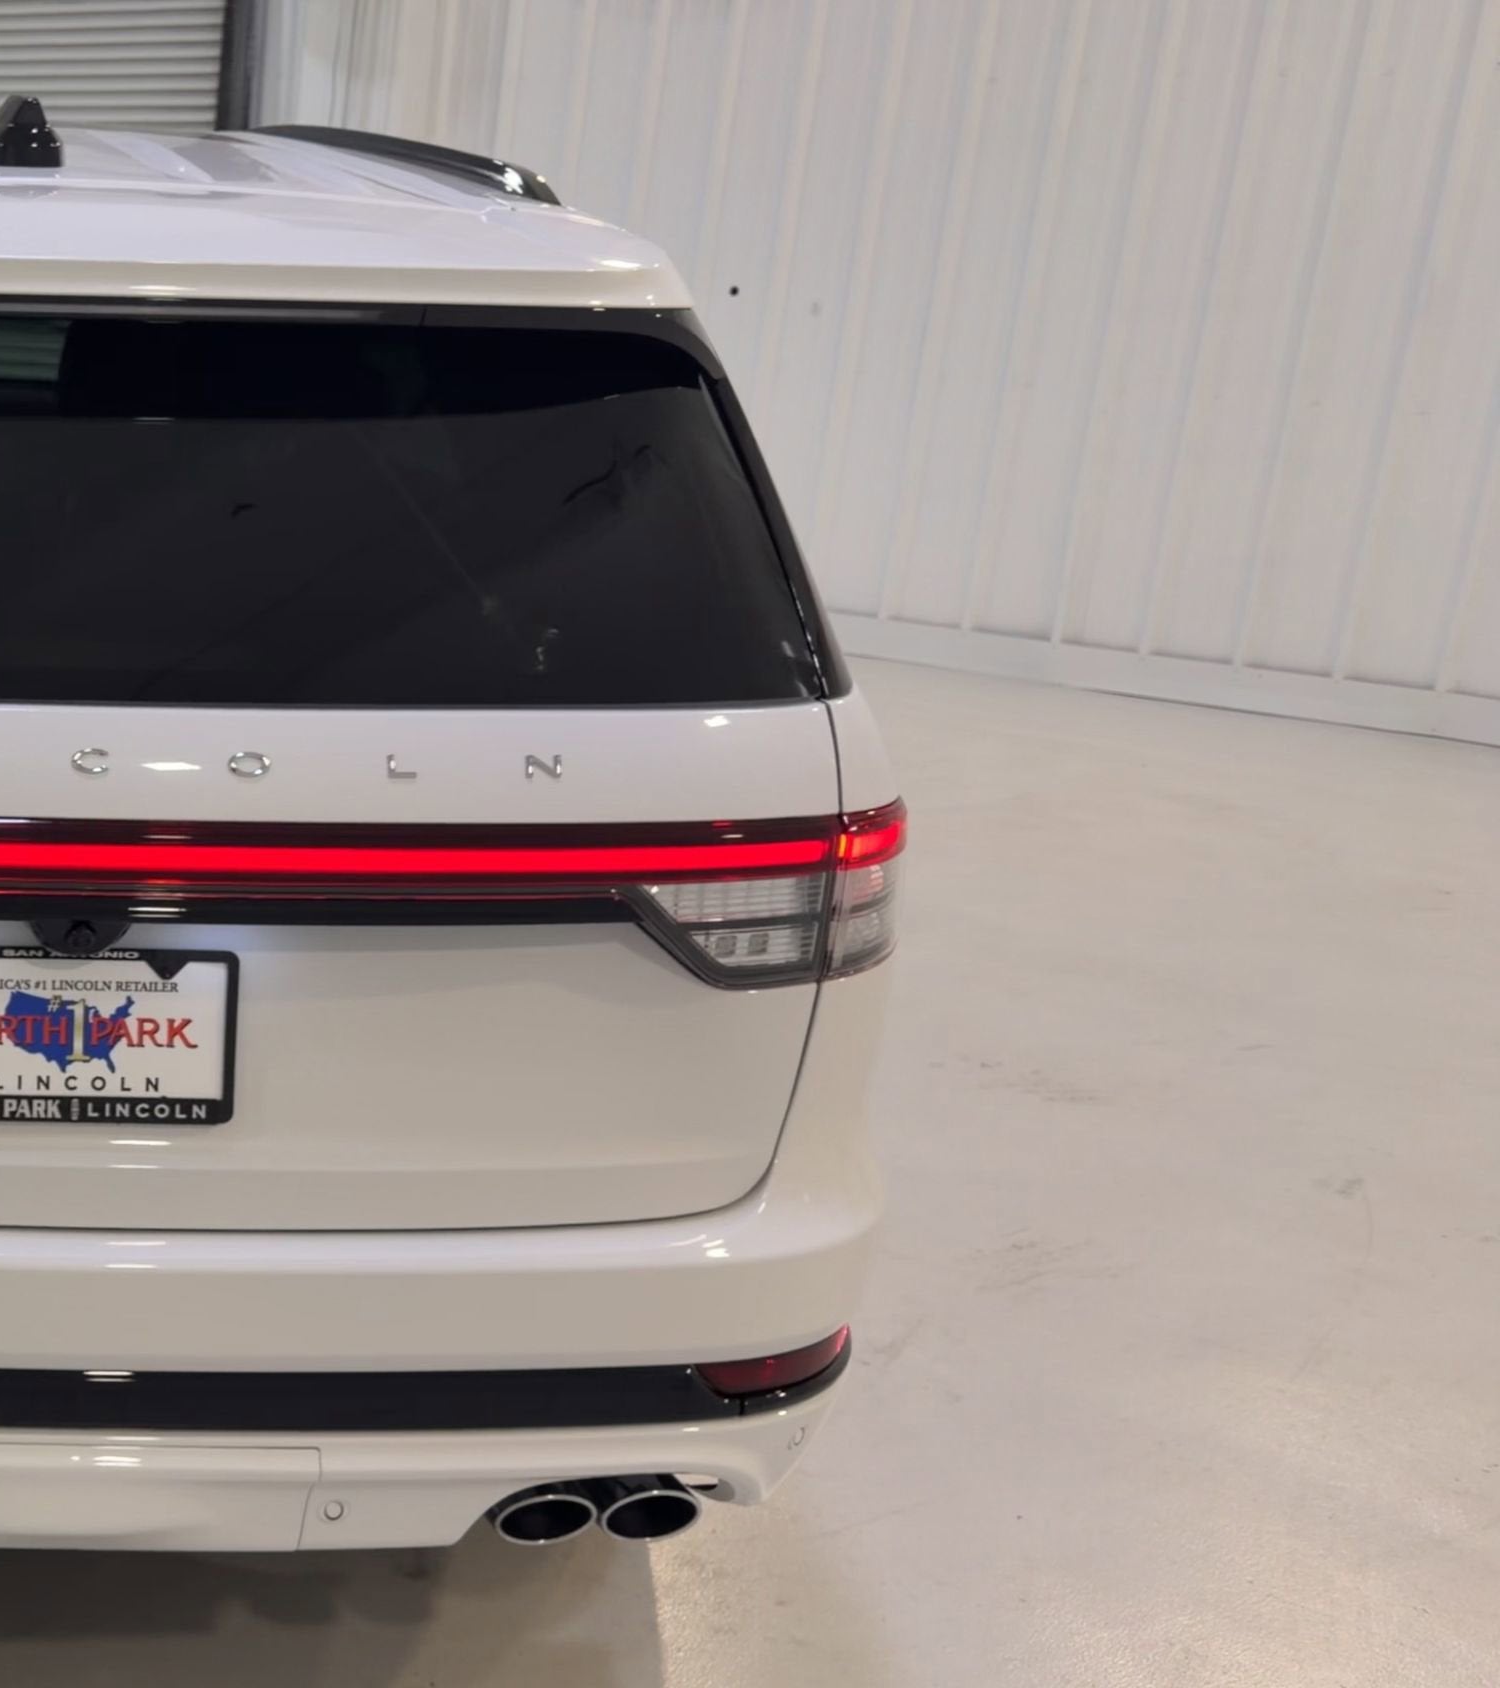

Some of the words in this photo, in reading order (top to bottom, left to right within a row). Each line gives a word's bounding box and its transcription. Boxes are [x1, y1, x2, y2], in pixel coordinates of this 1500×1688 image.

[1, 949, 43, 957] SAN
[49, 950, 140, 959] AONIO
[34, 980, 47, 990] #1
[52, 980, 112, 992] LINCOLN
[115, 981, 179, 993] RETAILER
[90, 1017, 198, 1049] PARK
[2, 1098, 62, 1119] PARK
[86, 1102, 207, 1120] LINCOLN
